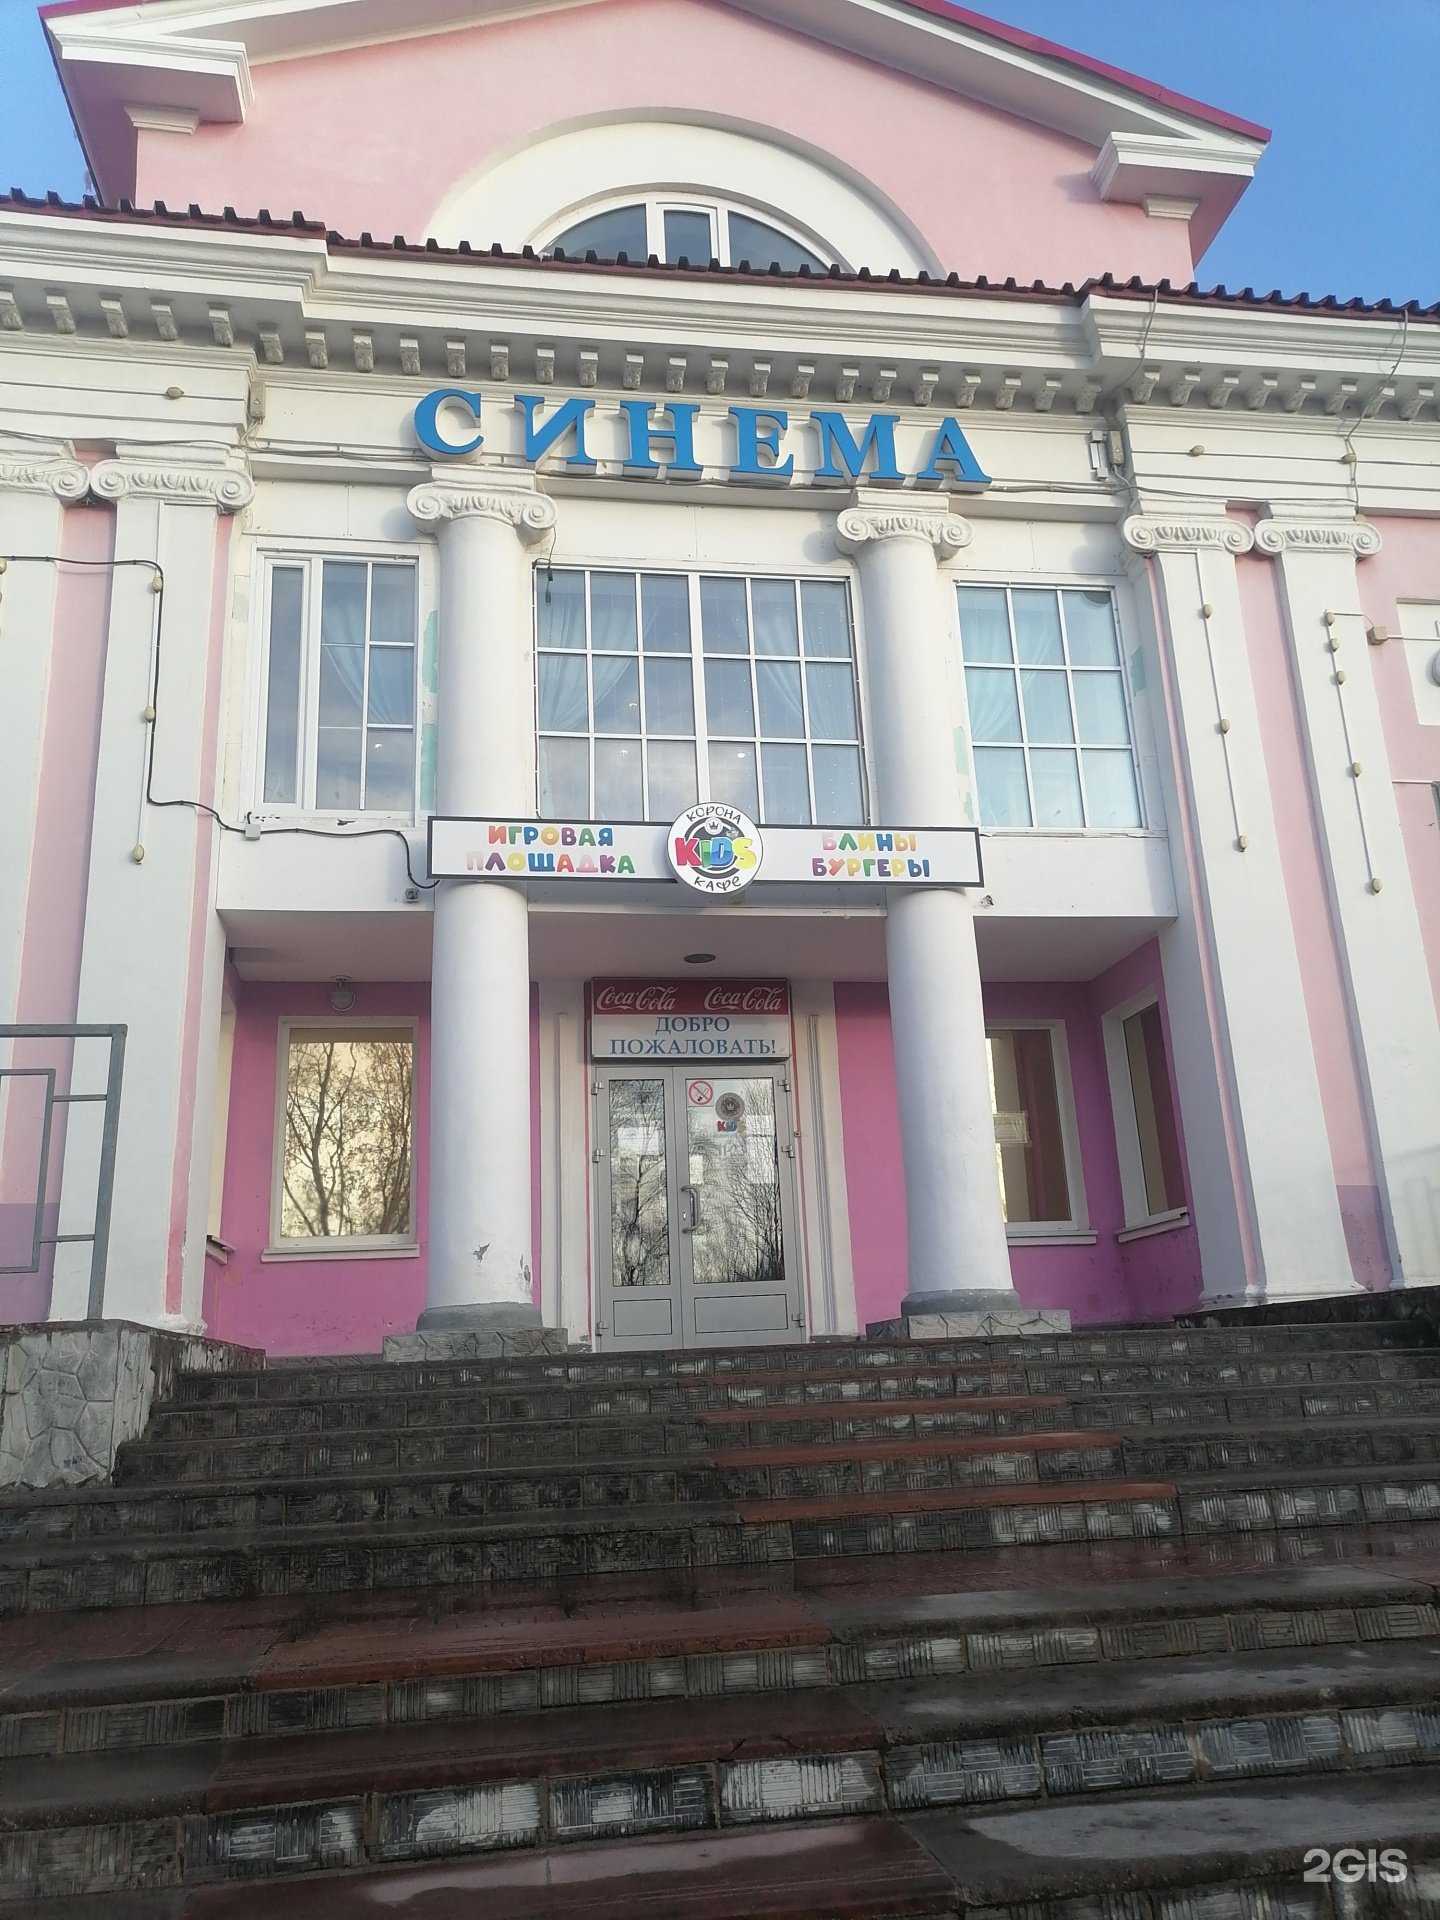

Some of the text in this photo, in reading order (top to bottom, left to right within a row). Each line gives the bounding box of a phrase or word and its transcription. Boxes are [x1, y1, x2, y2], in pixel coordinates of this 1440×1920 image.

[413, 388, 991, 484] СИНЕМА
[686, 806, 740, 824] КОРОНА
[488, 825, 613, 847] ИГРОВАЯ
[822, 832, 916, 852] БЛИНЫ
[467, 852, 636, 874] ПЛОЩАДКА
[674, 836, 757, 870] KIDS
[811, 857, 930, 878] БУРГЕРЫ
[655, 1016, 730, 1035] ДОБРО
[610, 1039, 776, 1055] ПОЖАЛОВАТЬ!
